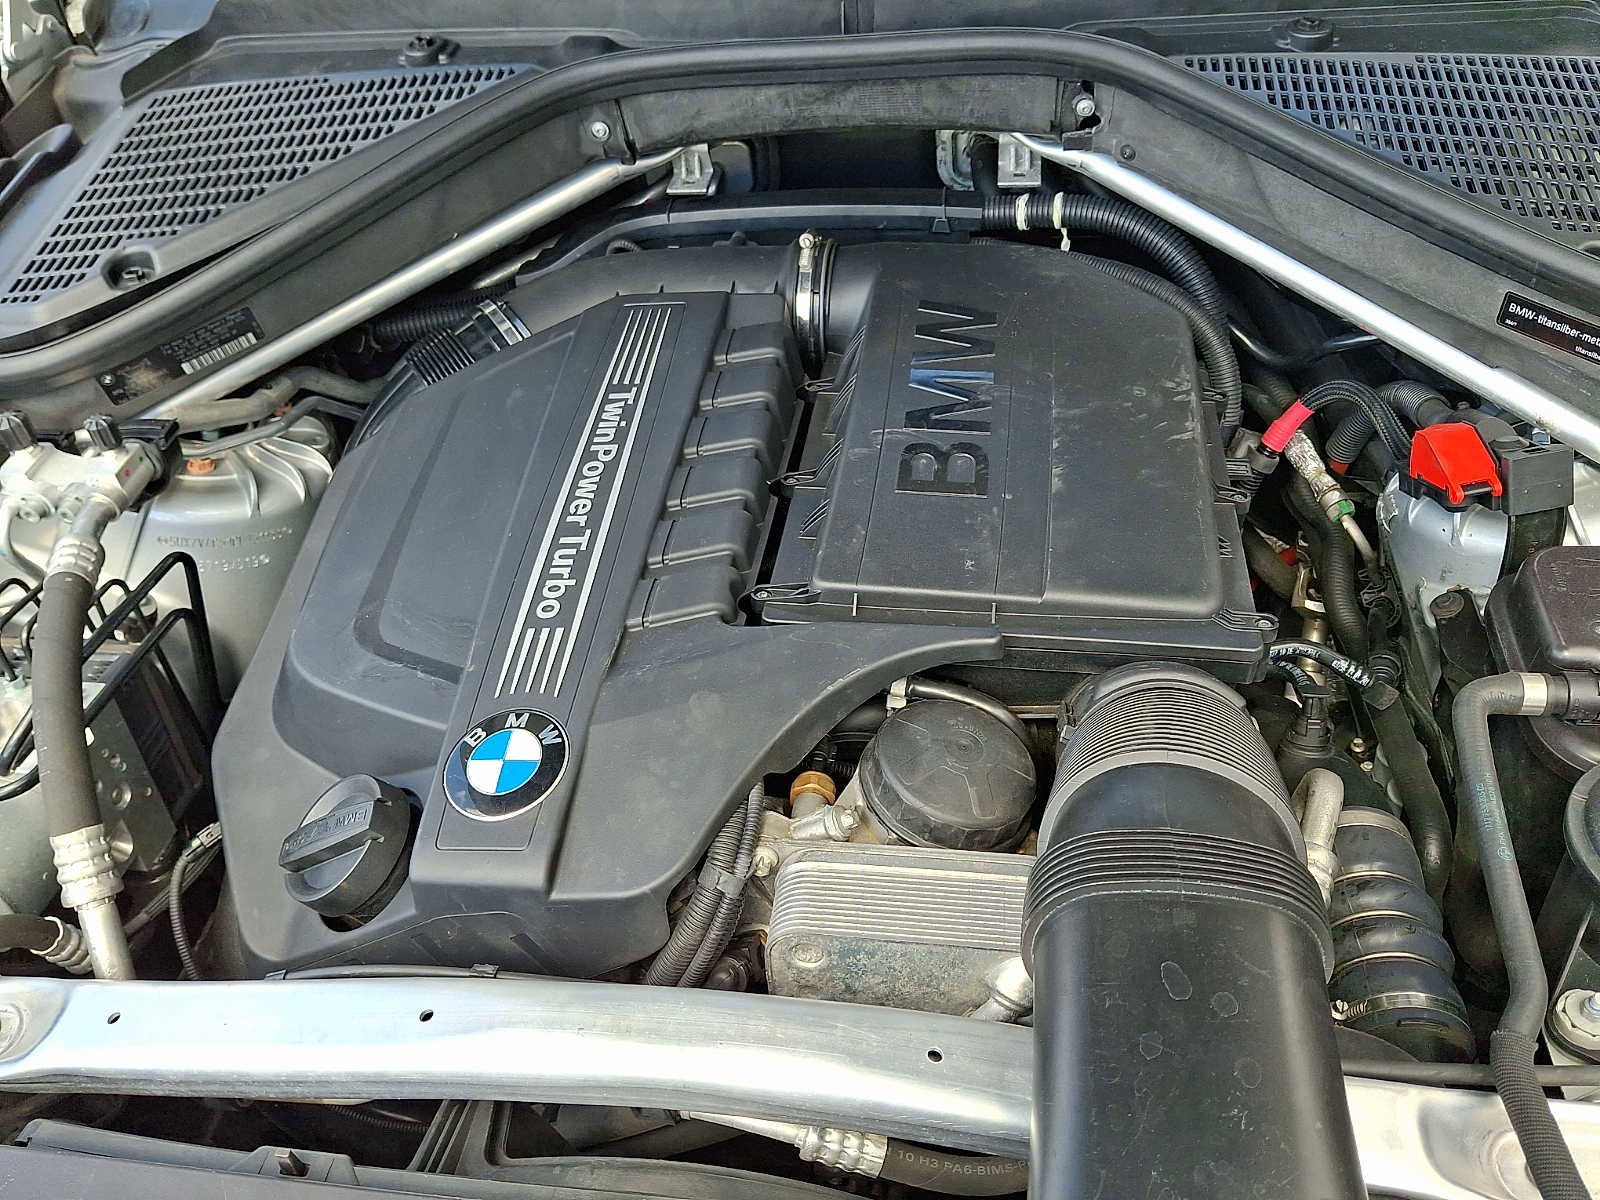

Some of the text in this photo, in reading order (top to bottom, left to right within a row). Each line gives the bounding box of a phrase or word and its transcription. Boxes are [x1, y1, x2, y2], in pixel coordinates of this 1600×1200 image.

[895, 300, 998, 498] BMW
[535, 386, 637, 620] TwinPower Turbo
[464, 712, 562, 749] BMW
[919, 1156, 939, 1168] H3
